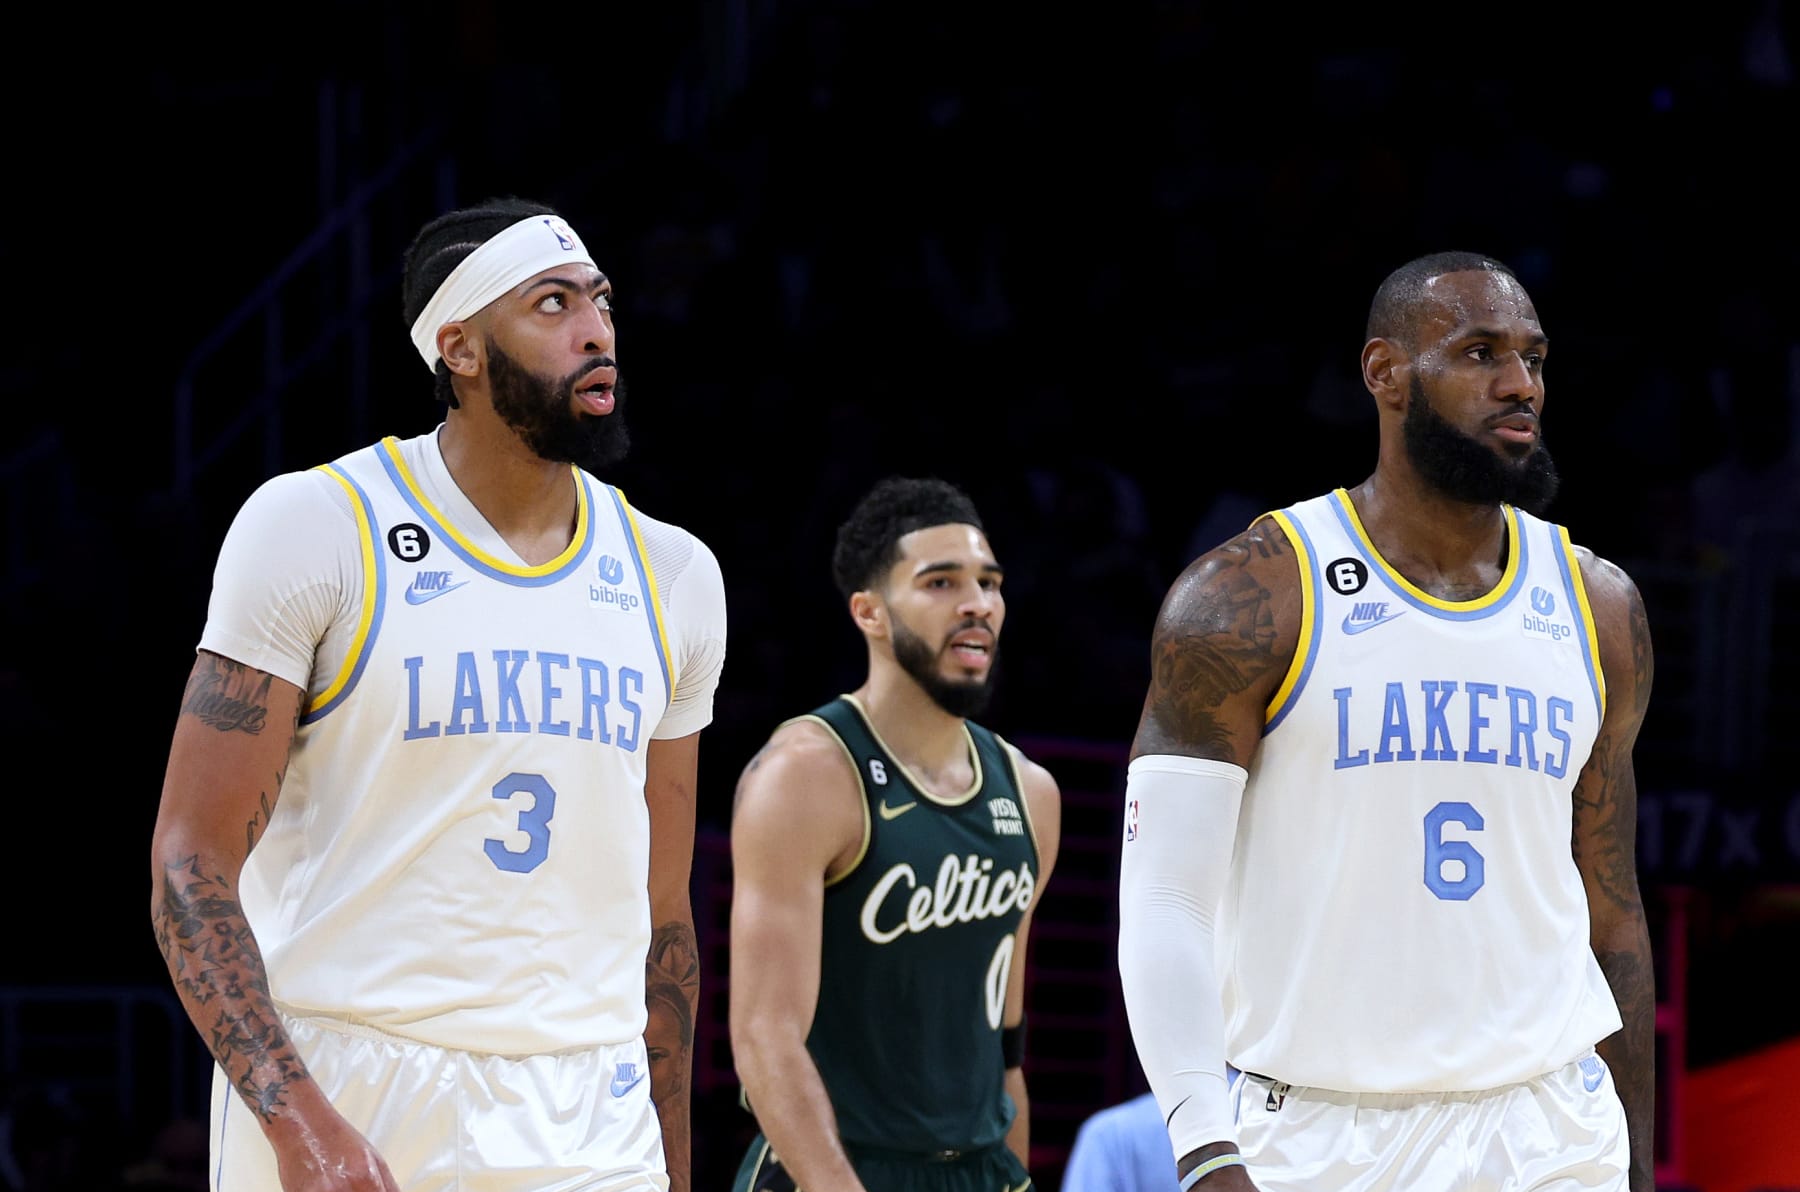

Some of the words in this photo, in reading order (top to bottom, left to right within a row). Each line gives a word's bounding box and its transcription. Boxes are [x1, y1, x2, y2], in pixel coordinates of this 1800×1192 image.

[396, 528, 421, 559] 6
[413, 570, 455, 591] NIKE
[1334, 563, 1359, 592] 6
[589, 585, 639, 611] bibigo
[1351, 602, 1390, 622] NIKE
[1523, 614, 1571, 641] bibigo
[403, 649, 643, 753] LAKERS
[1333, 680, 1574, 780] LAKERS
[869, 759, 888, 785] 6
[988, 797, 1021, 818] VISTA
[483, 772, 557, 874] 3
[993, 819, 1024, 835] PRINT
[1423, 801, 1485, 902] 6
[861, 853, 1034, 944] Celtics
[985, 934, 1015, 1030] 0
